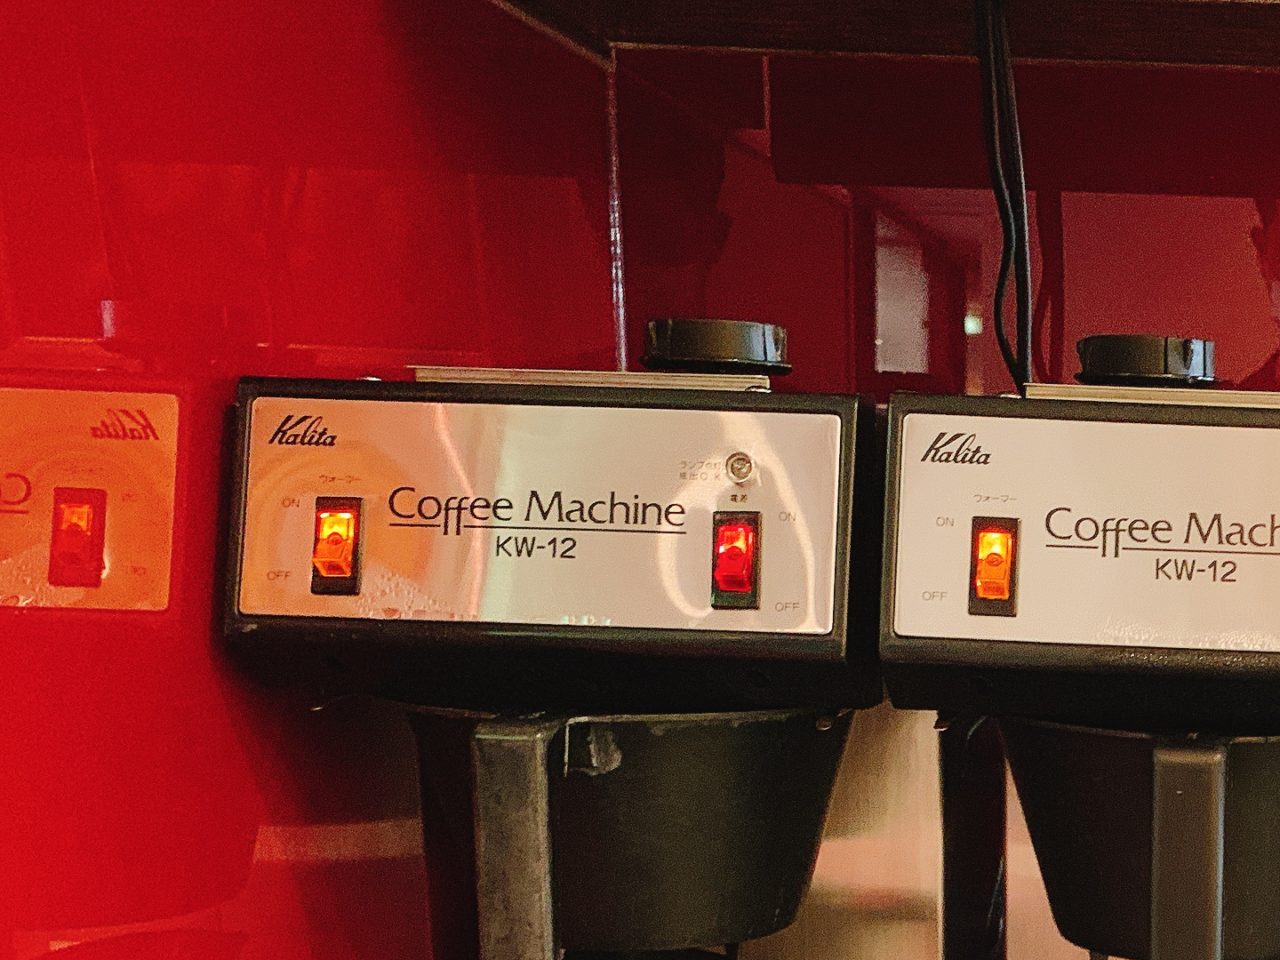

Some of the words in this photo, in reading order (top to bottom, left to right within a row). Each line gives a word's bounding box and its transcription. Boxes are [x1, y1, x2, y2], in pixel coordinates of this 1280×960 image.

[268, 414, 337, 447] Kalita
[920, 432, 992, 465] Kalita
[388, 486, 513, 536] Coffee
[524, 490, 686, 527] Machine
[778, 511, 797, 522] ON
[936, 516, 955, 527] ON
[1045, 507, 1173, 559] Coffee
[495, 536, 577, 560] KW-12
[266, 571, 292, 581] OFF
[1155, 558, 1237, 583] KW-12
[774, 602, 800, 612] OFF
[921, 590, 948, 601] OFF
